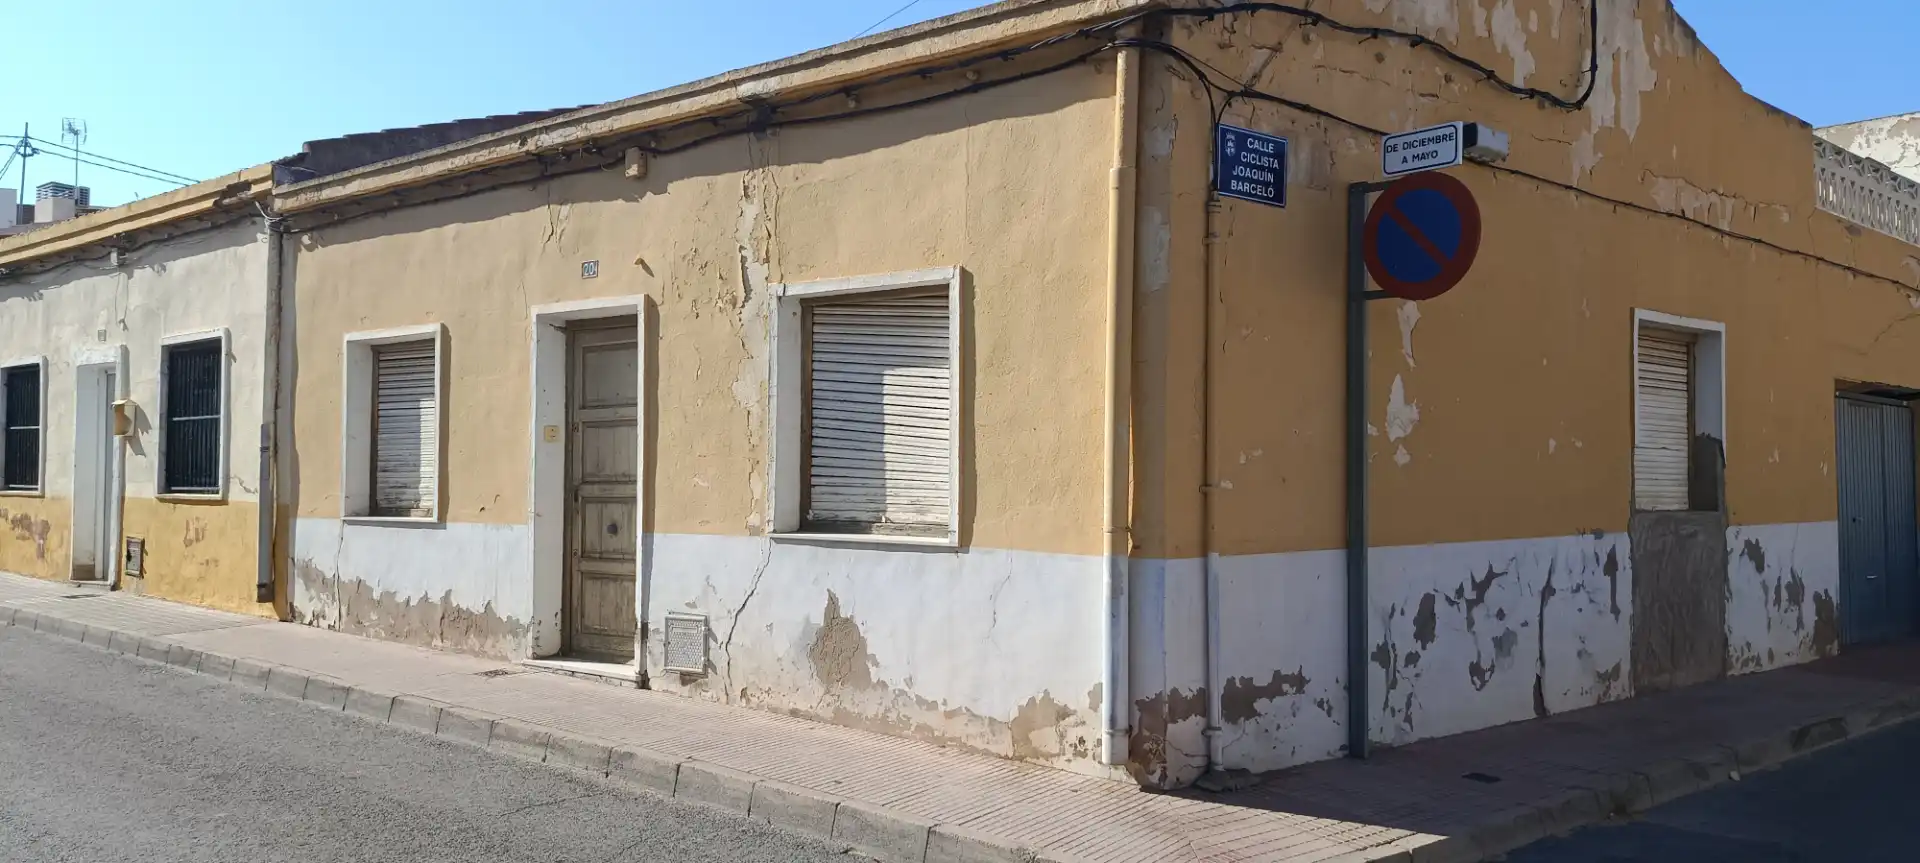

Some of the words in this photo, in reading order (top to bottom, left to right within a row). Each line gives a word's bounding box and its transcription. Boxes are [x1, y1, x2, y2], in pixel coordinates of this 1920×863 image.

[1247, 138, 1275, 154] CALLE
[1386, 143, 1399, 154] DE
[1402, 132, 1455, 150] DICIEMBRE
[1240, 151, 1280, 170] CICLISTA
[1401, 156, 1408, 165] A
[1412, 150, 1439, 163] MAYO
[1232, 164, 1274, 183] JOAQUÍN
[1230, 180, 1275, 198] BARCELÓ
